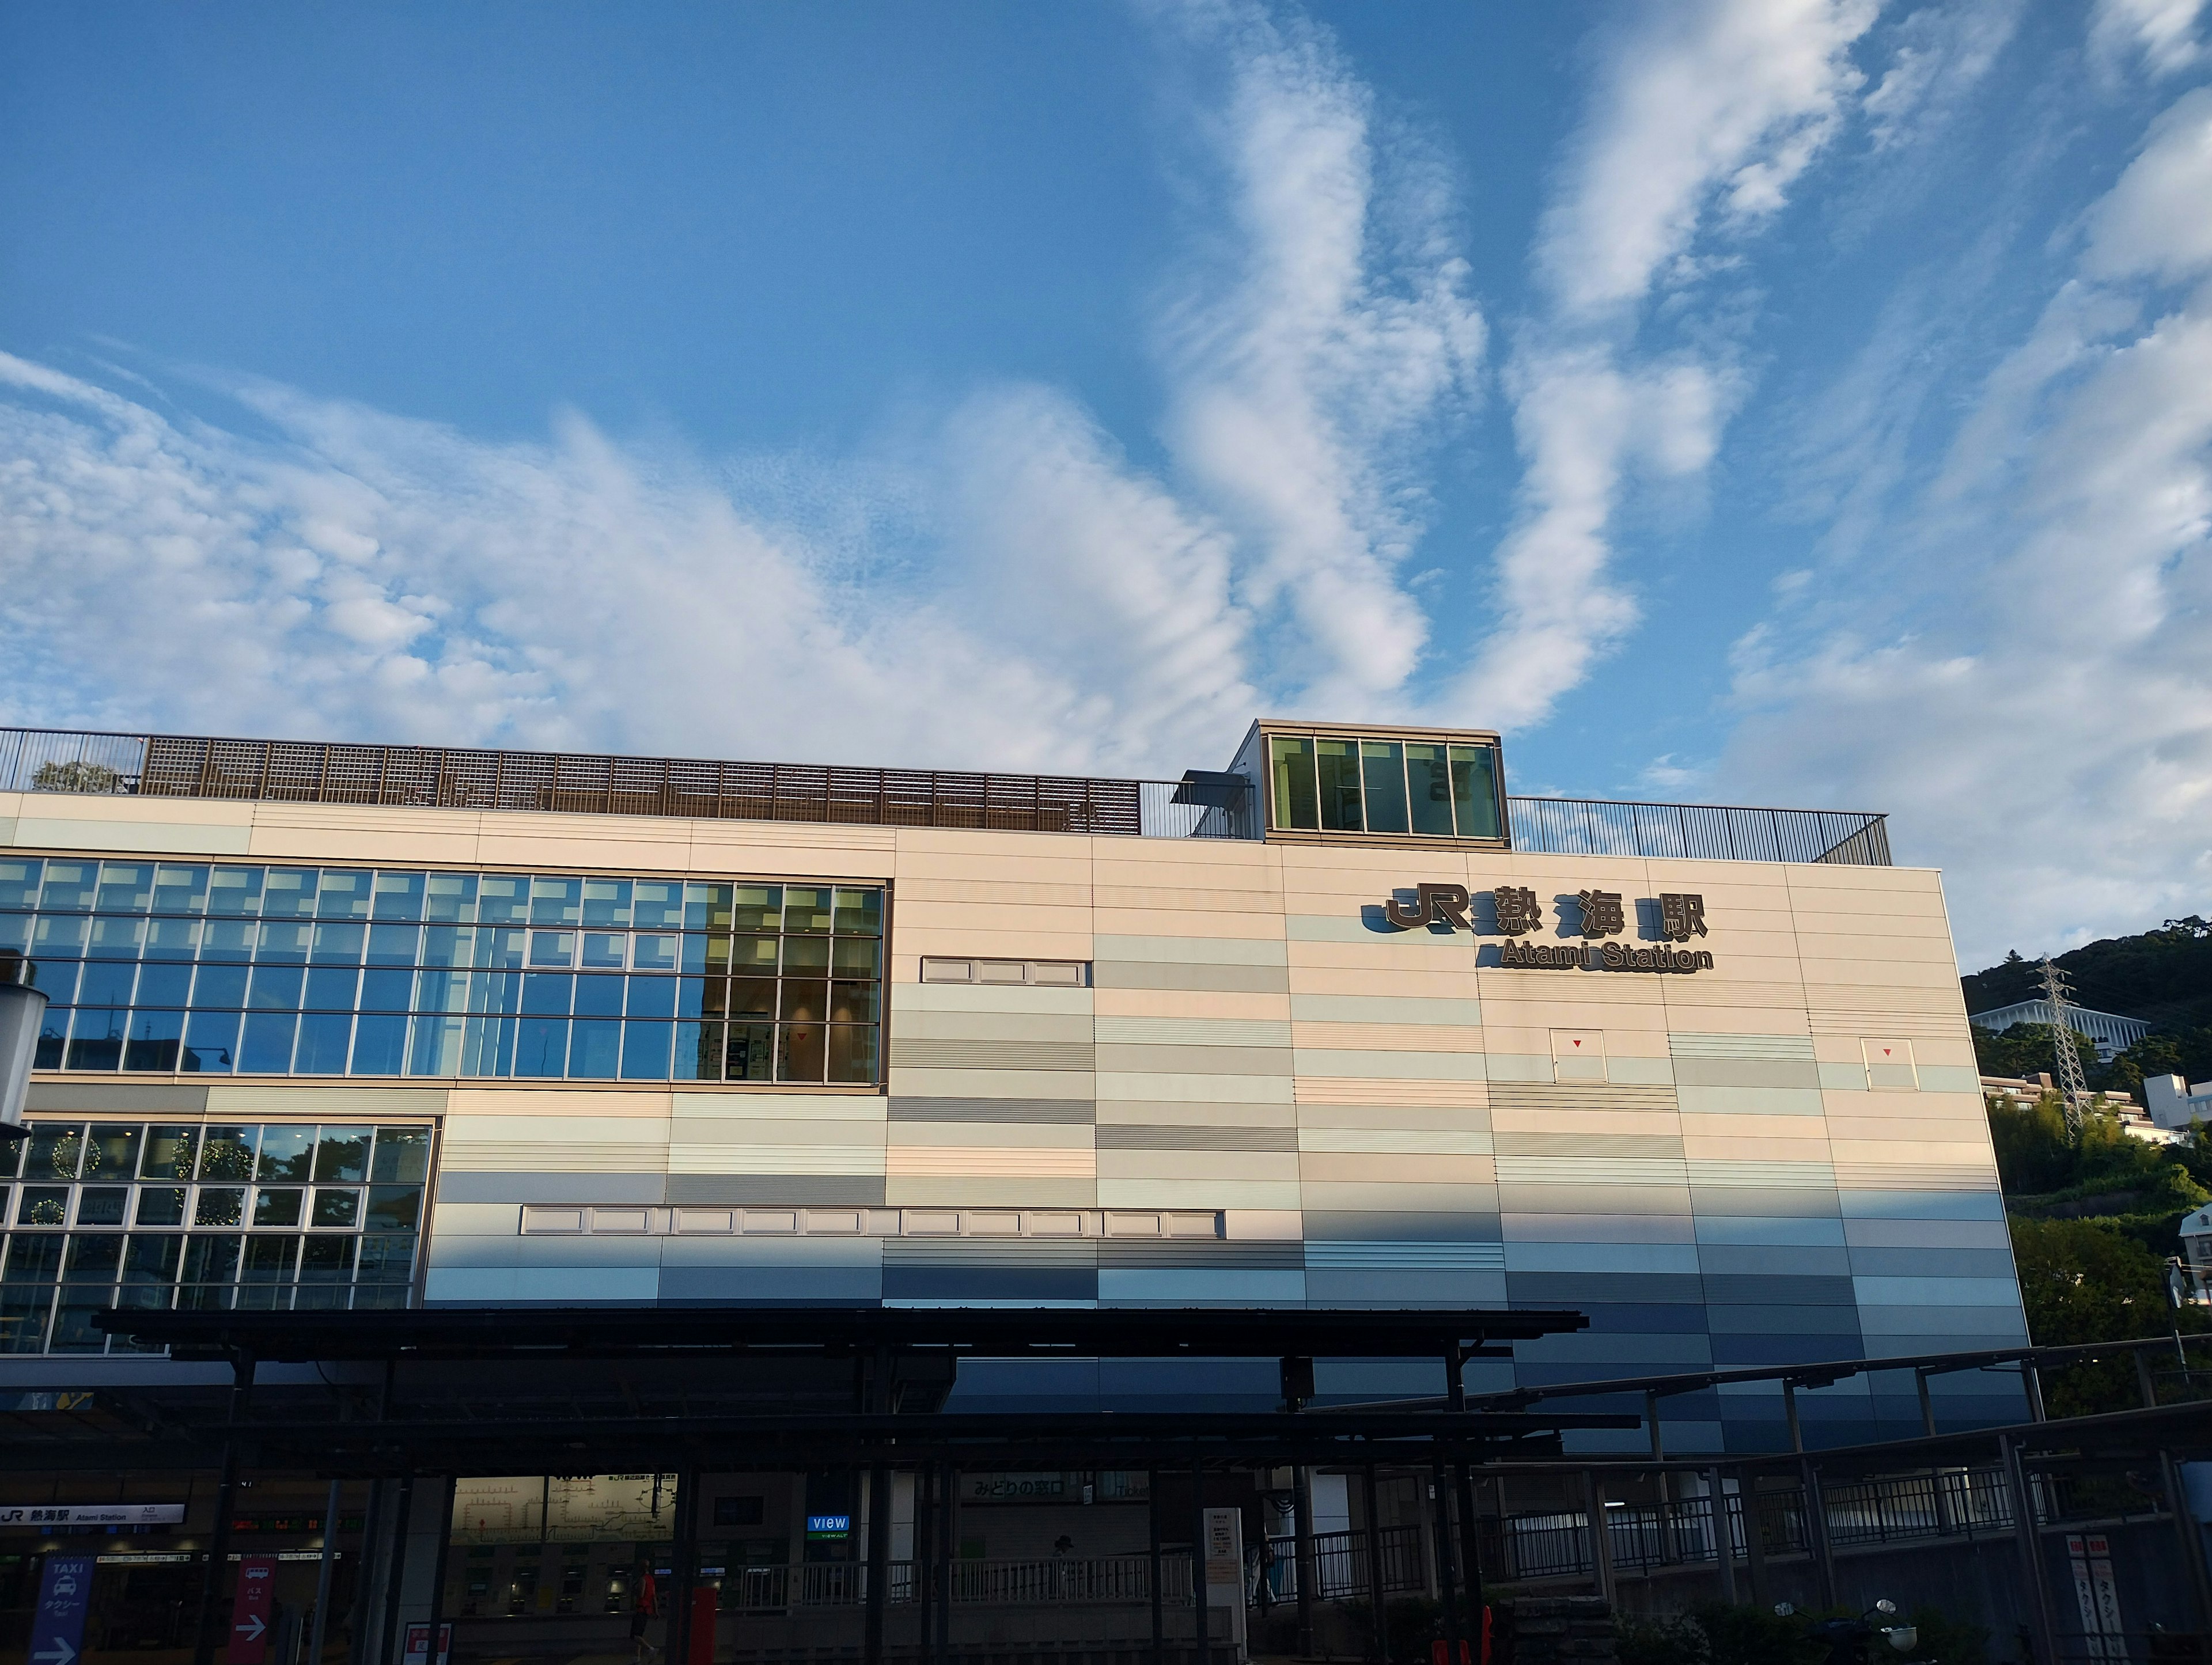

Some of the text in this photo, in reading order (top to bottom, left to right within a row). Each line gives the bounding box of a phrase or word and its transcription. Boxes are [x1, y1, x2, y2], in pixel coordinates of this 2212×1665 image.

[1385, 882, 1710, 939] JR 熱海駅
[1500, 939, 1714, 970] Atami Station
[974, 1480, 1065, 1496] みどりの窓口
[1, 1509, 70, 1522] JR 熱海駅
[100, 1513, 126, 1521] Station
[54, 1563, 84, 1573] TAXI
[44, 1600, 81, 1609] タクシー
